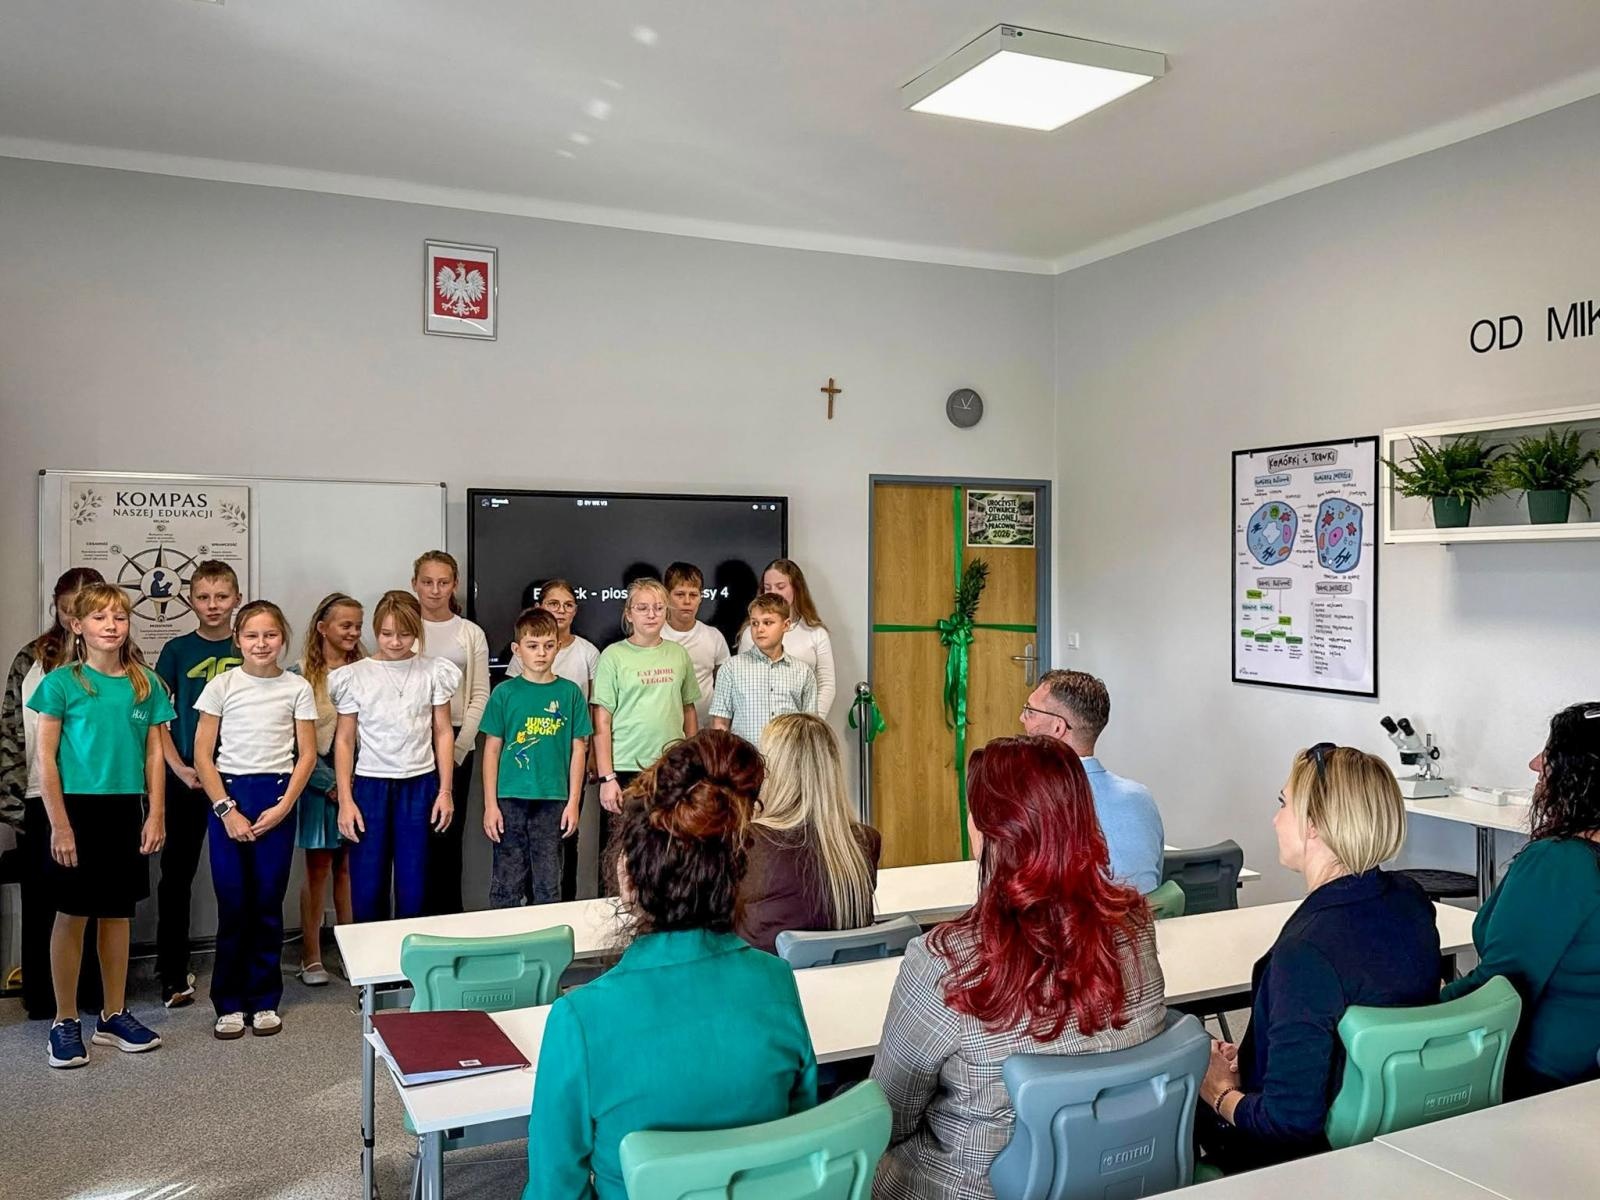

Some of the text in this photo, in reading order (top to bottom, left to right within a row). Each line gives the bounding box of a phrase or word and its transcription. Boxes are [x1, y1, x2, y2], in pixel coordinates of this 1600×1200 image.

[1470, 315, 1523, 353] OD
[116, 492, 208, 508] KOMPAS
[987, 499, 1017, 507] UROCZYSTE
[113, 508, 213, 519] NASZEJ EDUKACJI
[987, 513, 1018, 522] ZIELONEJ
[720, 586, 729, 598] 4
[186, 656, 243, 682] 4F
